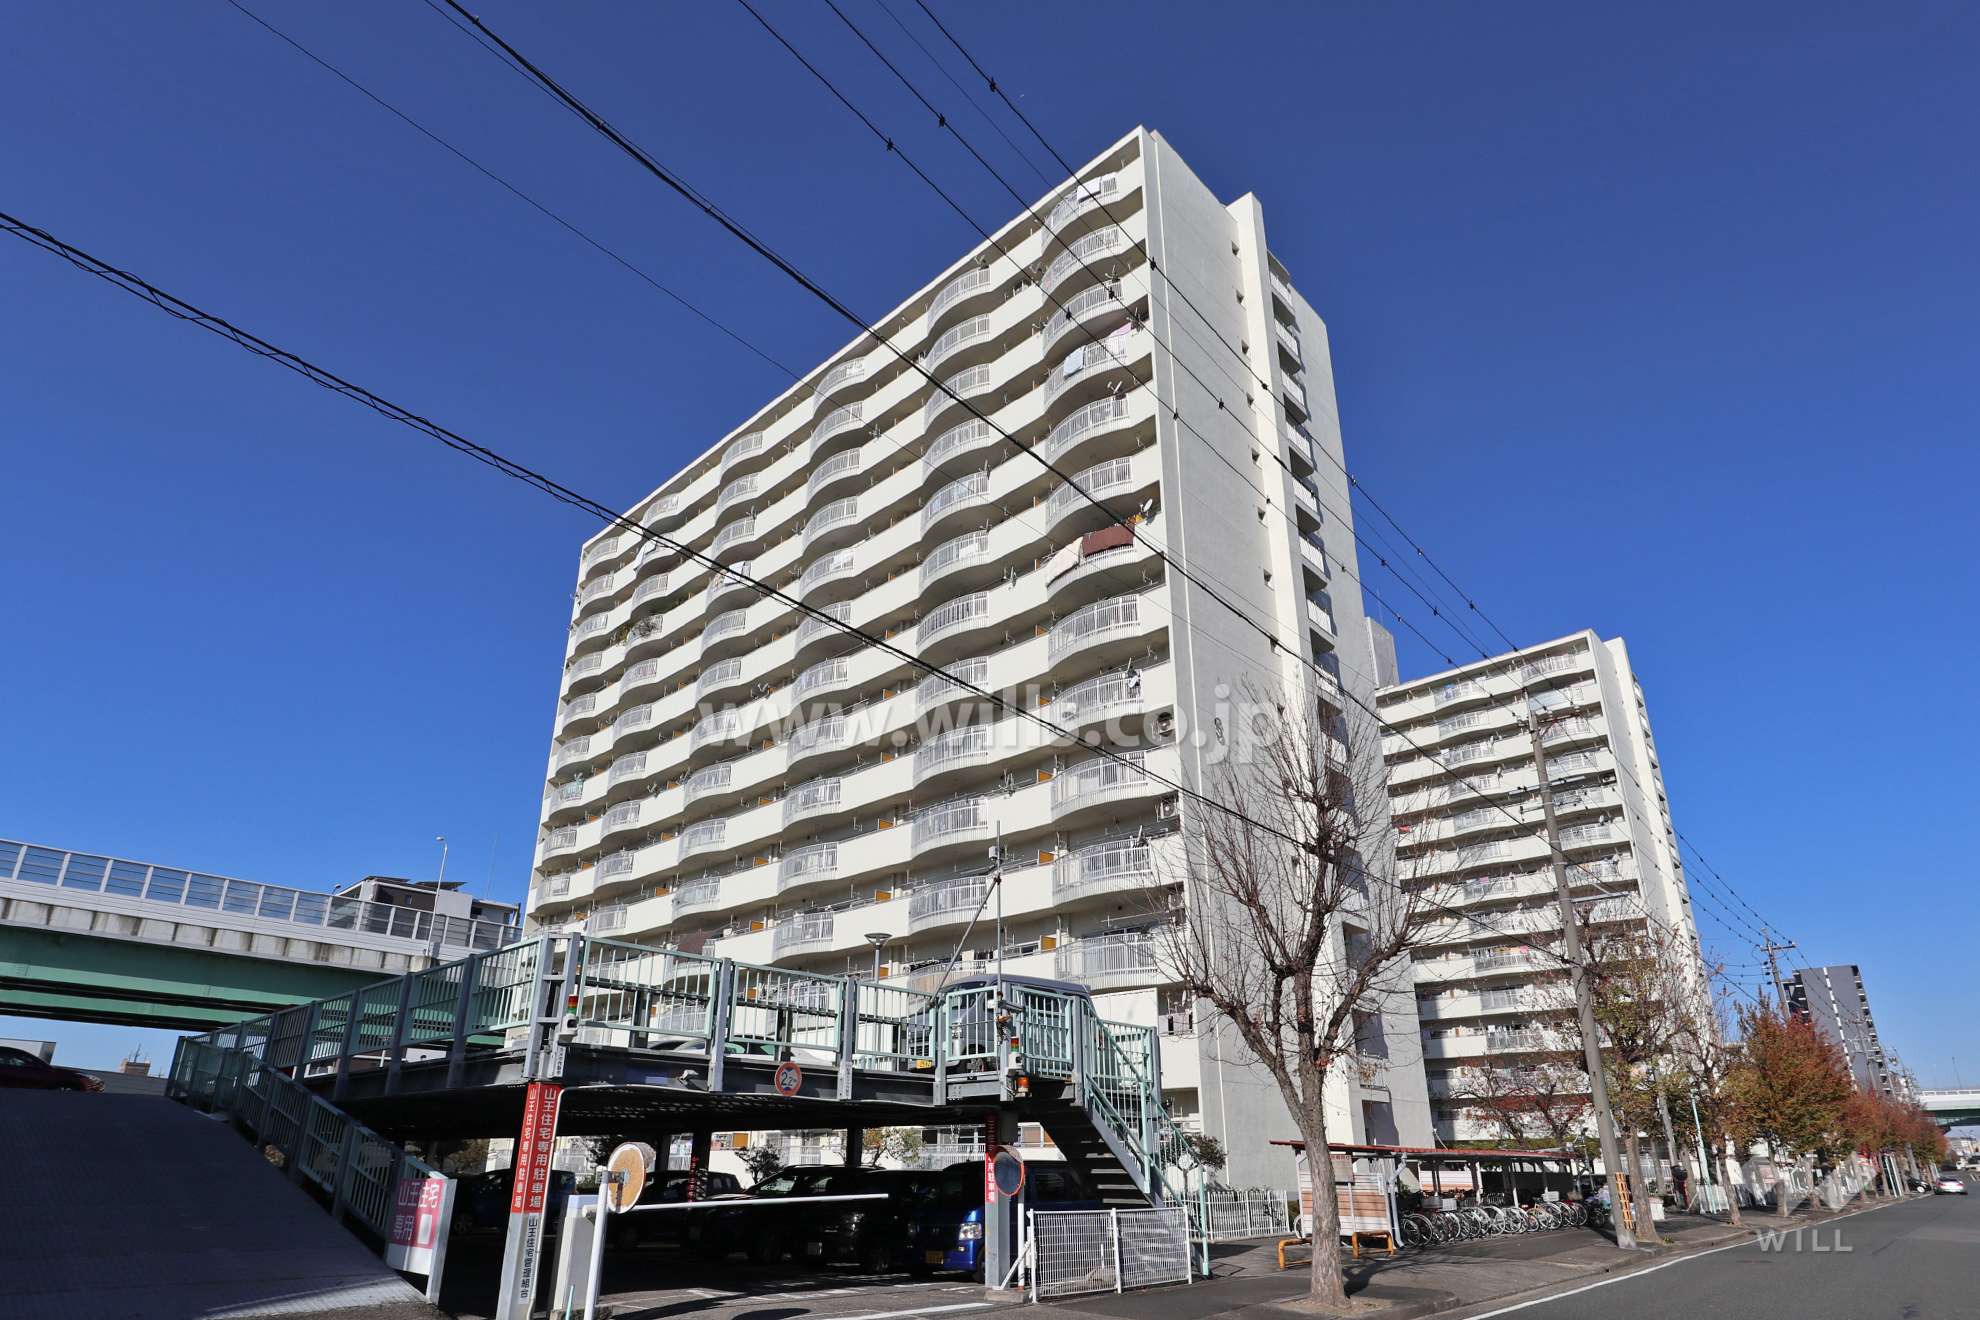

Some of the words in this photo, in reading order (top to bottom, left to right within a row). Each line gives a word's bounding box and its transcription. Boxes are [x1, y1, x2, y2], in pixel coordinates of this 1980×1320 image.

[529, 1086, 558, 1208] 山王住宅専用駐車場
[398, 1180, 441, 1209] 山王住宅
